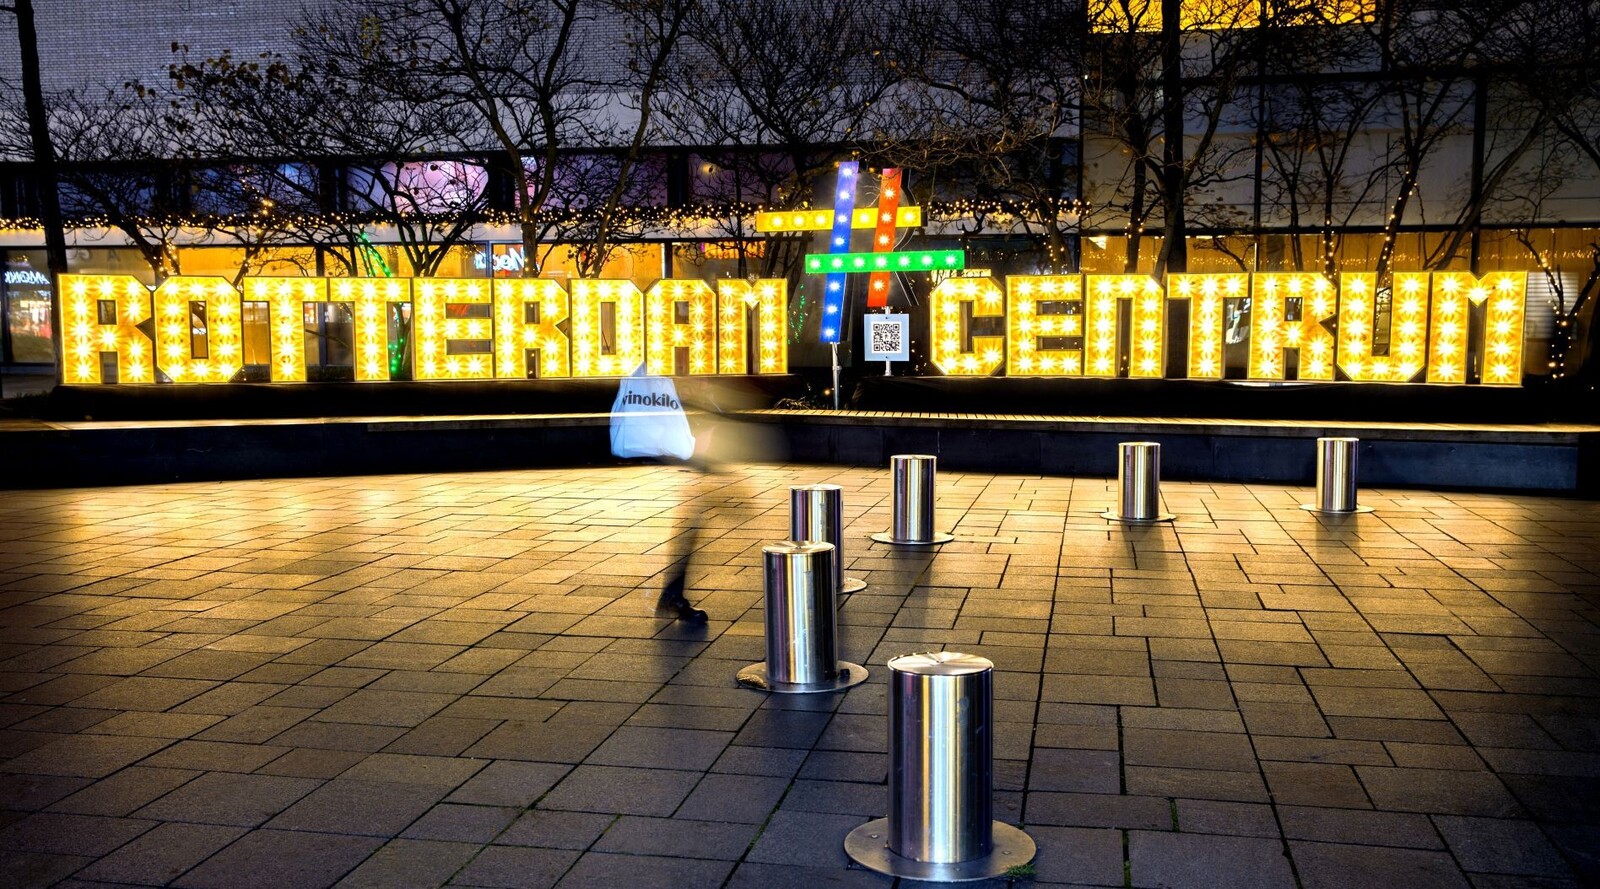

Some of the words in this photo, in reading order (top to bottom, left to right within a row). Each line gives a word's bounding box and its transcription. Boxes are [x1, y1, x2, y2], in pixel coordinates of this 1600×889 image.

[58, 274, 788, 384] ROTTERDAM
[930, 271, 1528, 387] CENTRUM
[622, 390, 679, 410] vinokilo
